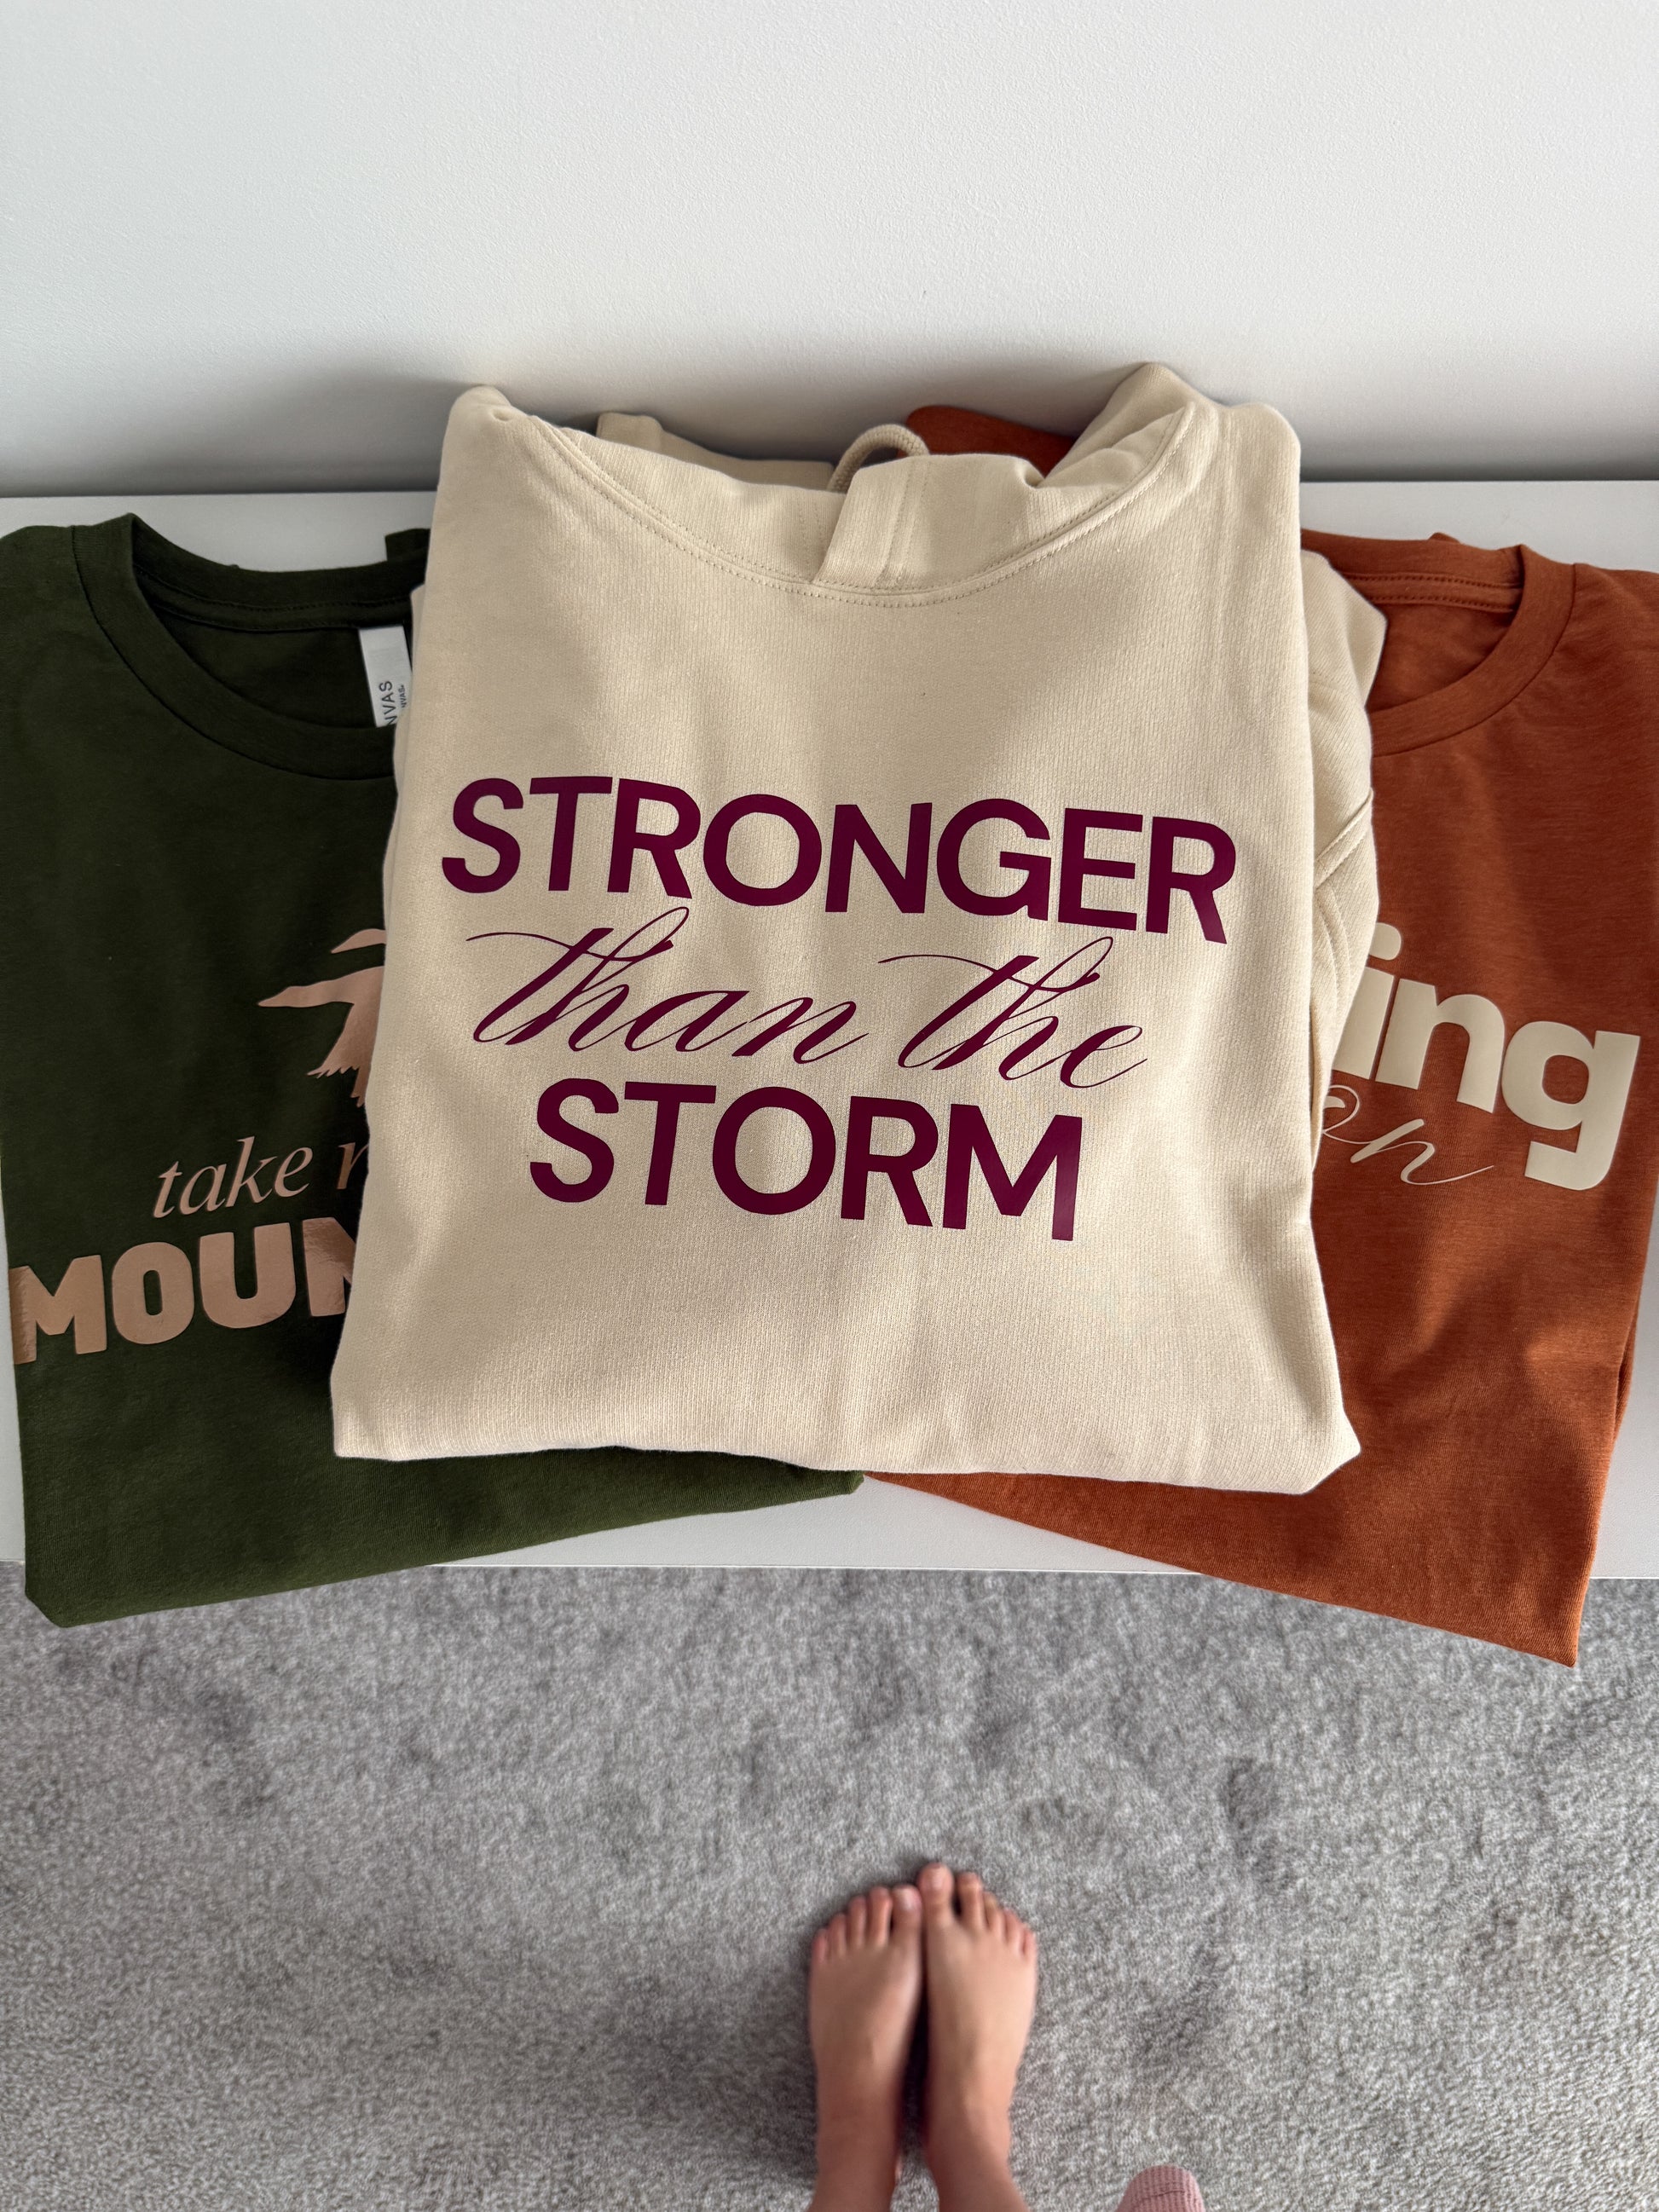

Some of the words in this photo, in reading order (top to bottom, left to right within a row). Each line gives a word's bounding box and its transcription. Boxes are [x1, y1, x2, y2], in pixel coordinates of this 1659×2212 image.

[442, 776, 1237, 945] STRONGER
[465, 906, 870, 1065] than
[877, 936, 1148, 1089] the
[153, 1135, 314, 1218] take
[529, 1077, 1083, 1242] STORM
